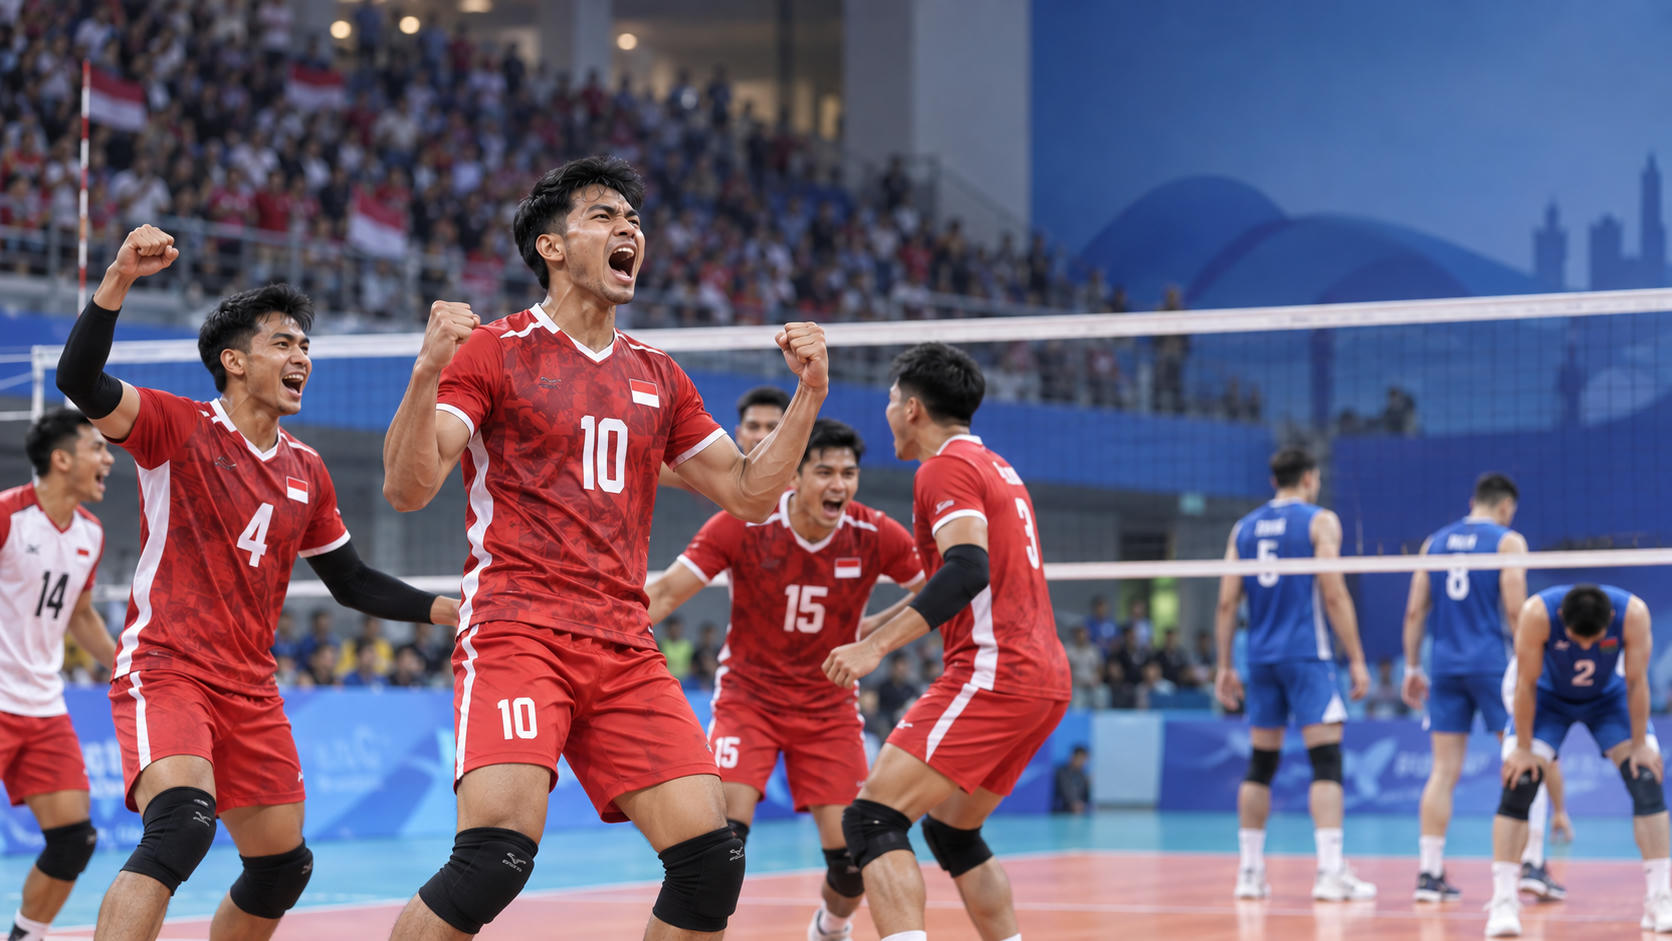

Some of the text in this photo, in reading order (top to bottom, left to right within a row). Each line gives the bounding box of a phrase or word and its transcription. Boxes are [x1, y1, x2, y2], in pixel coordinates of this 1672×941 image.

[580, 415, 629, 494] 10
[236, 502, 274, 568] 4
[1013, 497, 1040, 570] 3
[35, 570, 70, 620] 14
[783, 585, 829, 634] 15
[1572, 659, 1596, 687] 2
[496, 696, 539, 740] 10
[715, 736, 741, 769] 15
